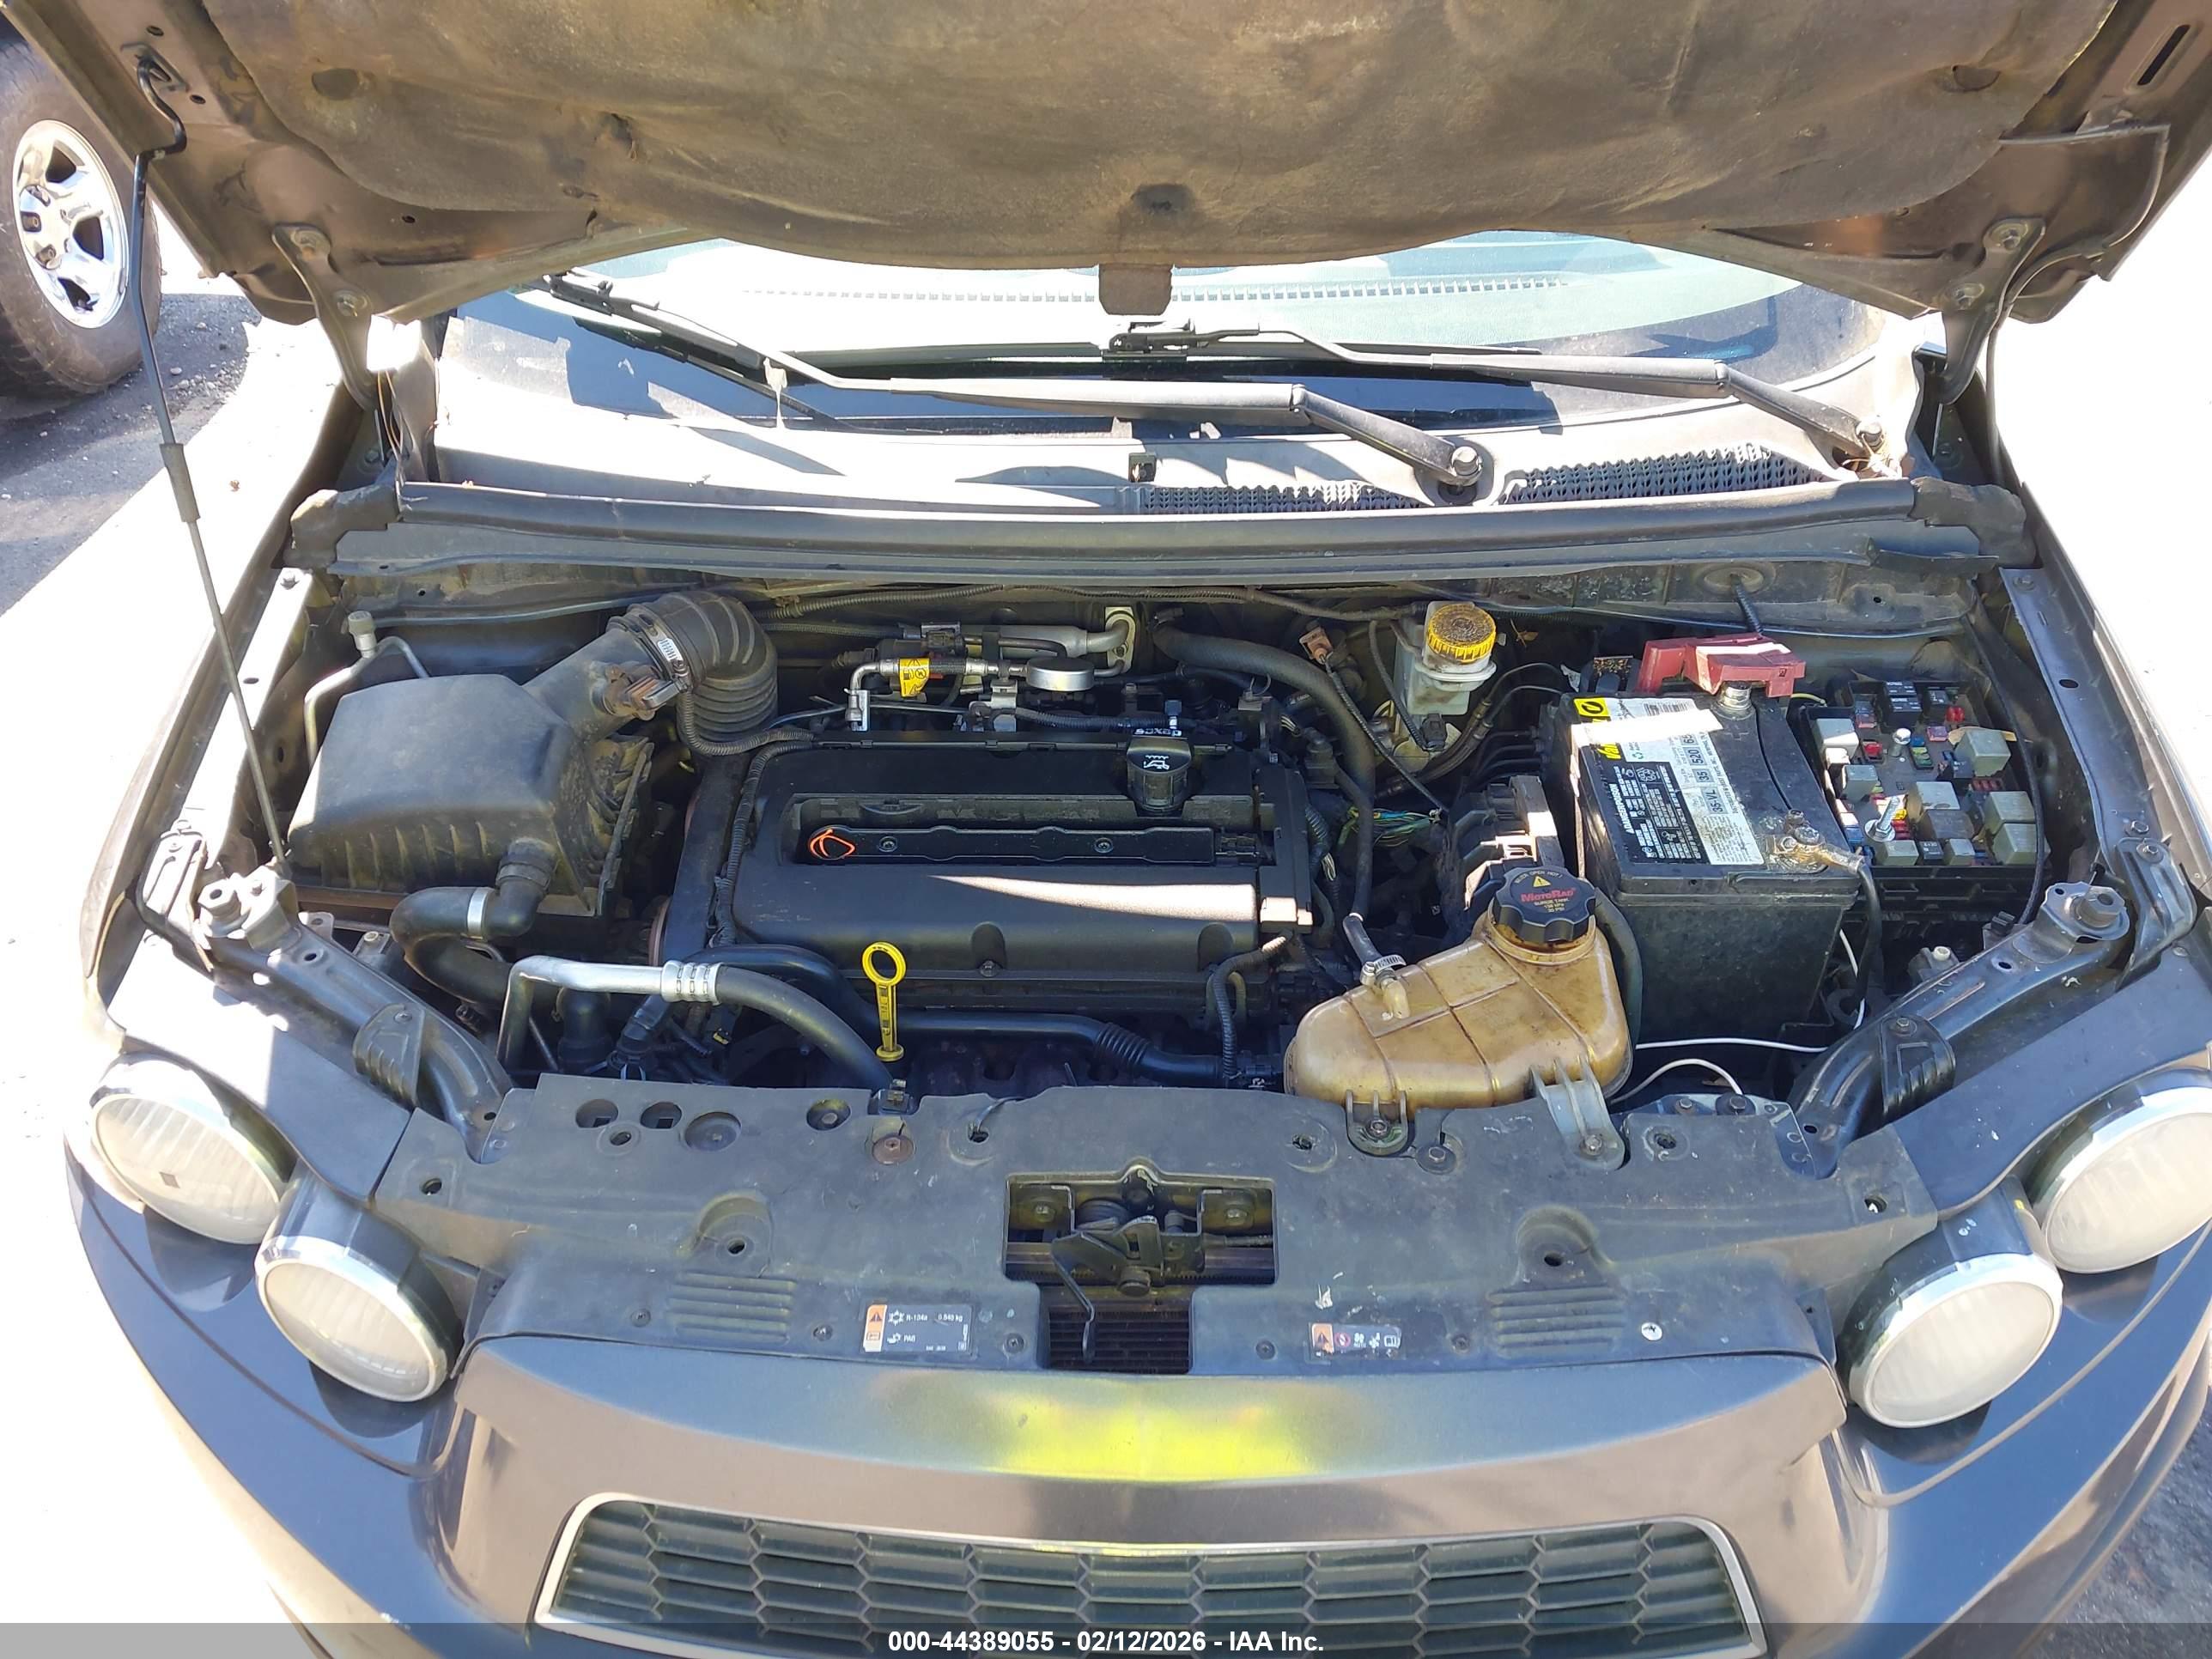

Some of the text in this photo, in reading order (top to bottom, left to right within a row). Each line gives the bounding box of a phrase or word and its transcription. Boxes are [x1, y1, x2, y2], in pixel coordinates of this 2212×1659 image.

[1687, 749, 1704, 764] 520
[1697, 771, 1710, 781] 35
[1705, 789, 1723, 812] 35-VL
